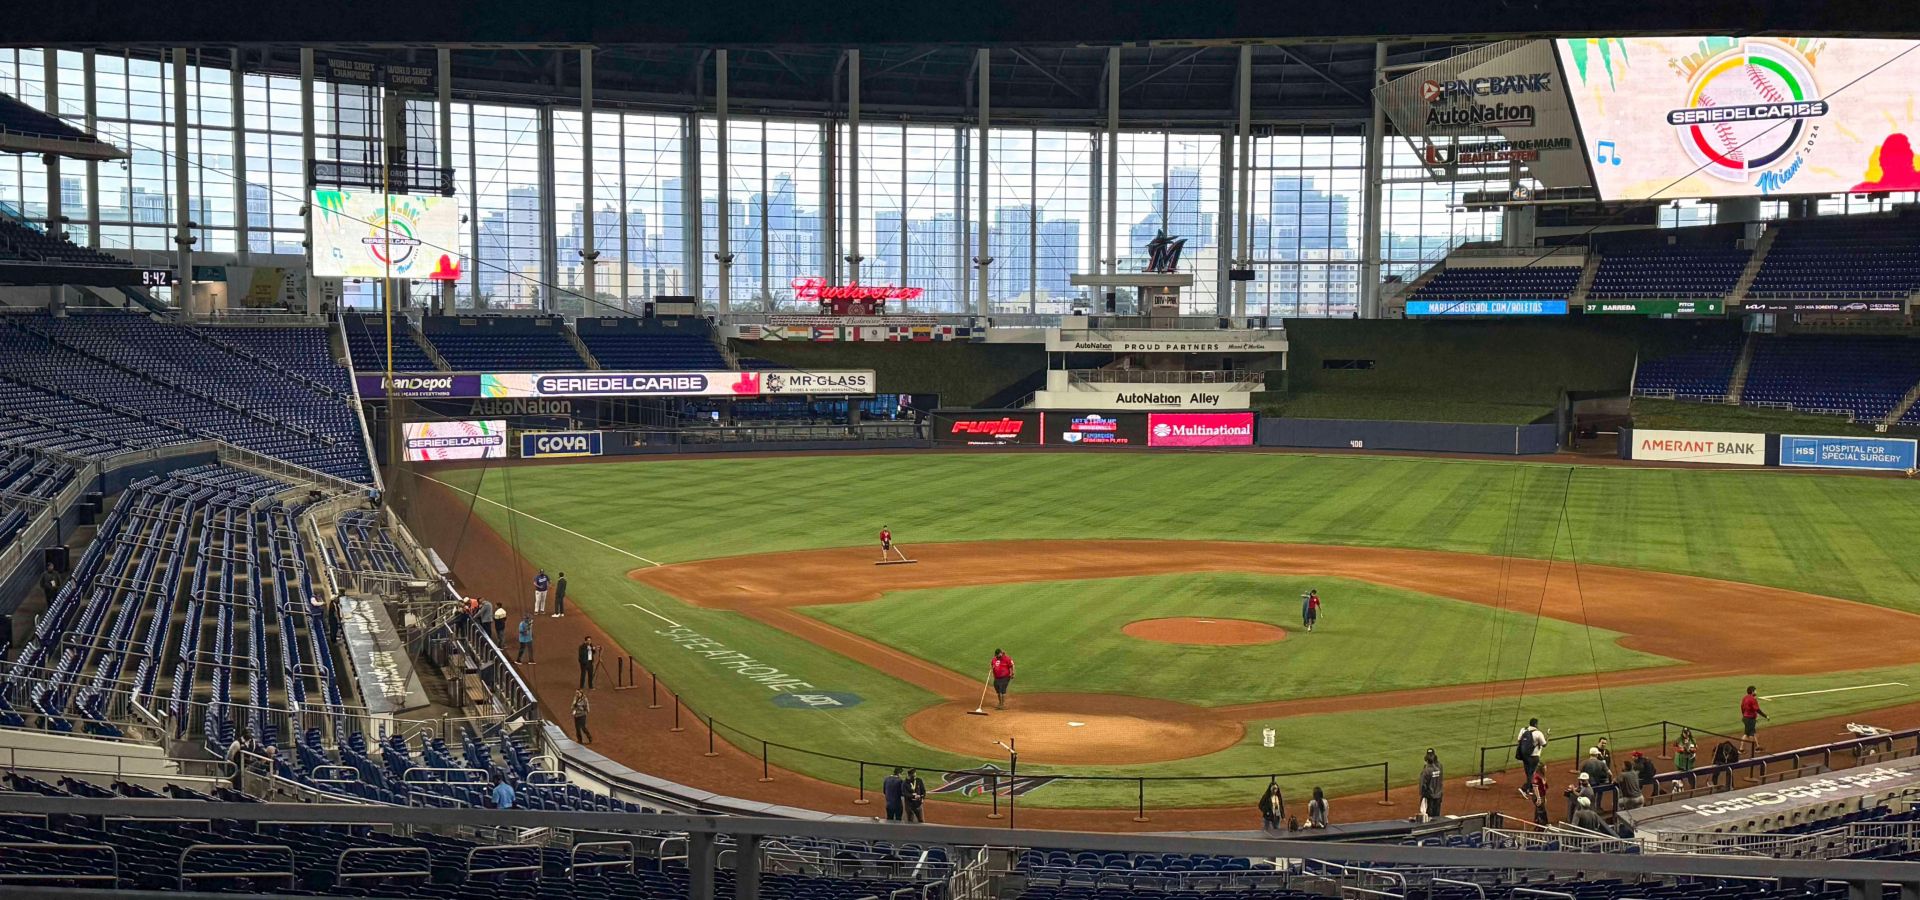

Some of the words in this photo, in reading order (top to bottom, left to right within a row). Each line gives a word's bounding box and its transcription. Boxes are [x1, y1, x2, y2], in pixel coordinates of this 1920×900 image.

[1426, 103, 1533, 126] AutoNation
[1672, 102, 1823, 124] SERIEDELCARIBE
[1803, 124, 1820, 153] 2024
[1460, 140, 1518, 153] UNIVERSITY
[1459, 152, 1495, 163] HEALTH
[1497, 150, 1538, 161] SYSTEM
[1754, 153, 1804, 195] Miami
[1512, 187, 1527, 198] 42
[142, 271, 166, 285] 9:42
[791, 276, 925, 301] Budweiser
[1587, 304, 1596, 312] 37
[1124, 343, 1161, 351] PROUD
[1166, 343, 1219, 351] PARTNERS
[543, 377, 702, 391] SERIEDELCARIBE
[1116, 393, 1182, 406] AutoNation
[1190, 392, 1220, 405] Alley
[470, 399, 572, 415] AutoNation
[1172, 423, 1250, 436] Multinational
[1875, 424, 1888, 432] 387
[409, 436, 501, 448] SERIEDELCARIBE
[537, 436, 587, 452] GOYA
[1641, 439, 1714, 453] AMERANT
[1717, 442, 1755, 455] BANK
[1795, 447, 1815, 455] HSS
[1822, 444, 1865, 453] HOSPITAL
[1867, 446, 1885, 454] FOR
[1822, 451, 1859, 461] SPECIAL
[1860, 453, 1902, 463] SURGERY
